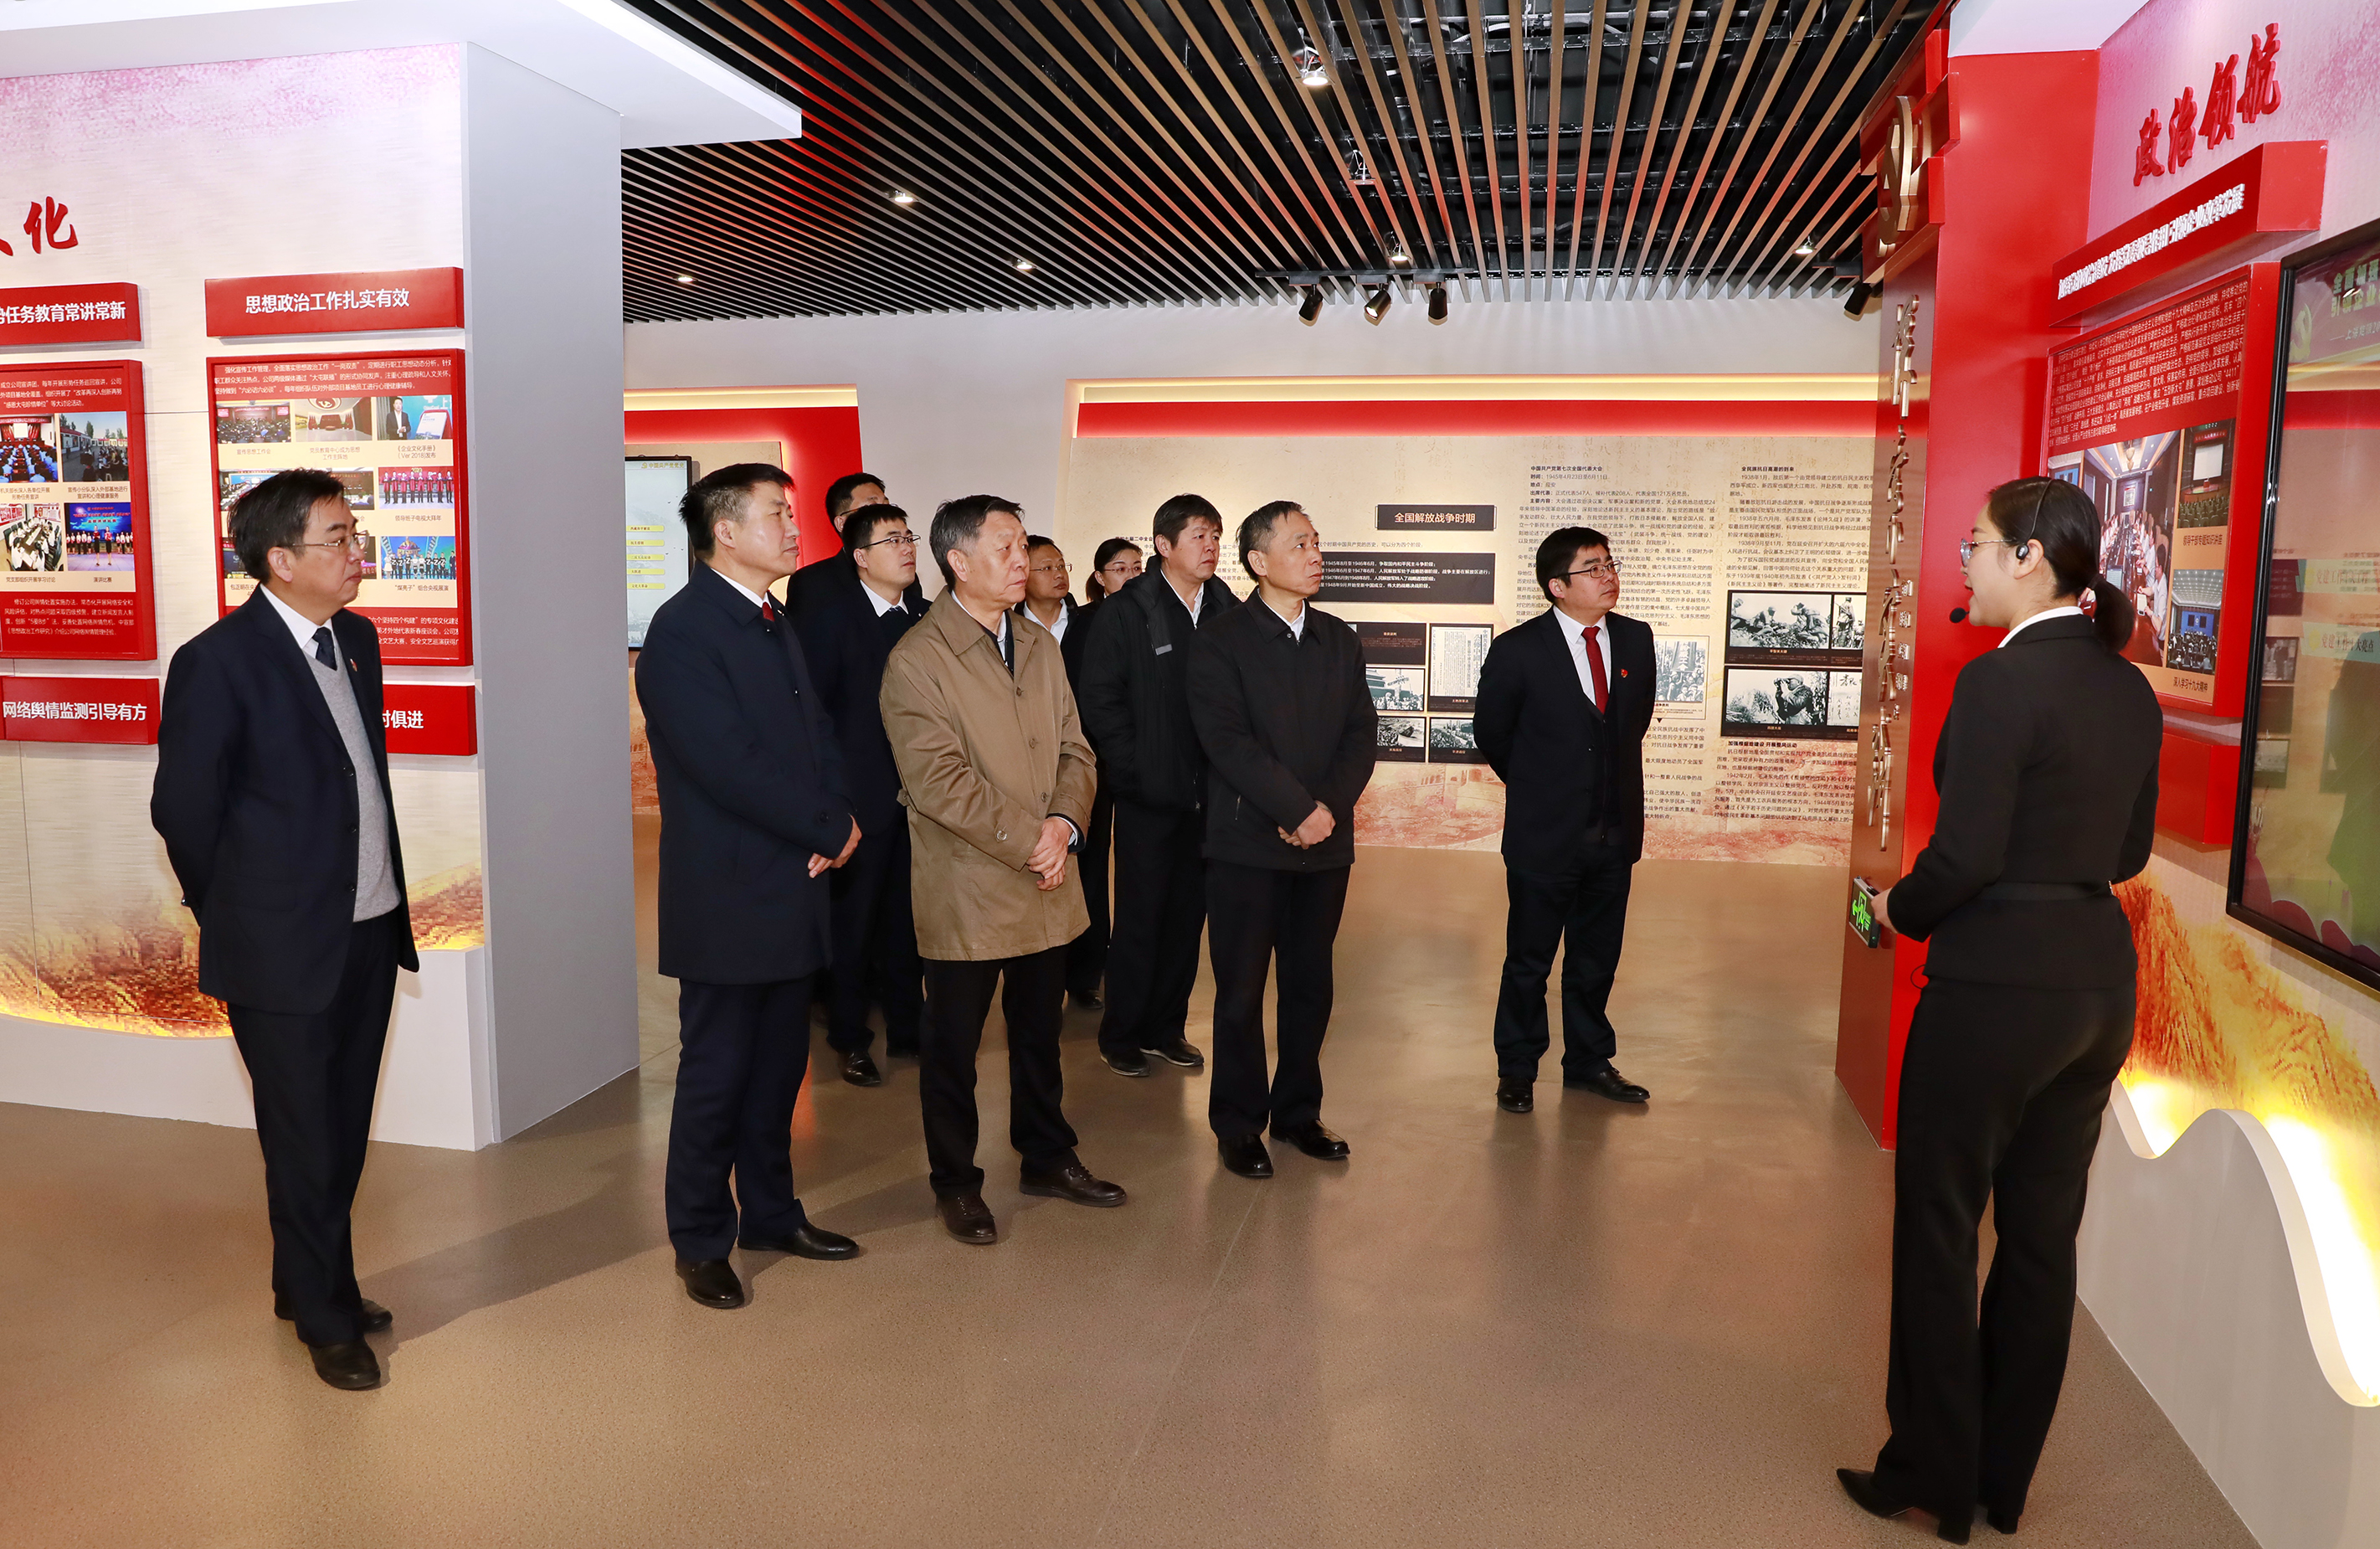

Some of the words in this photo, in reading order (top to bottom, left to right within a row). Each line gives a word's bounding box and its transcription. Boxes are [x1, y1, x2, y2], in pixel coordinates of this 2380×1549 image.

[2132, 22, 2282, 187] 政治领航
[0, 195, 79, 256] 化
[245, 288, 410, 314] 思想政治工作扎实有效
[396, 444, 437, 454] 《企业文化手册》
[1394, 512, 1476, 523] 全国解放战争时期
[2321, 632, 2374, 653] 党建工作十大亮点
[3, 701, 147, 722] 网络舆情监测引导有方
